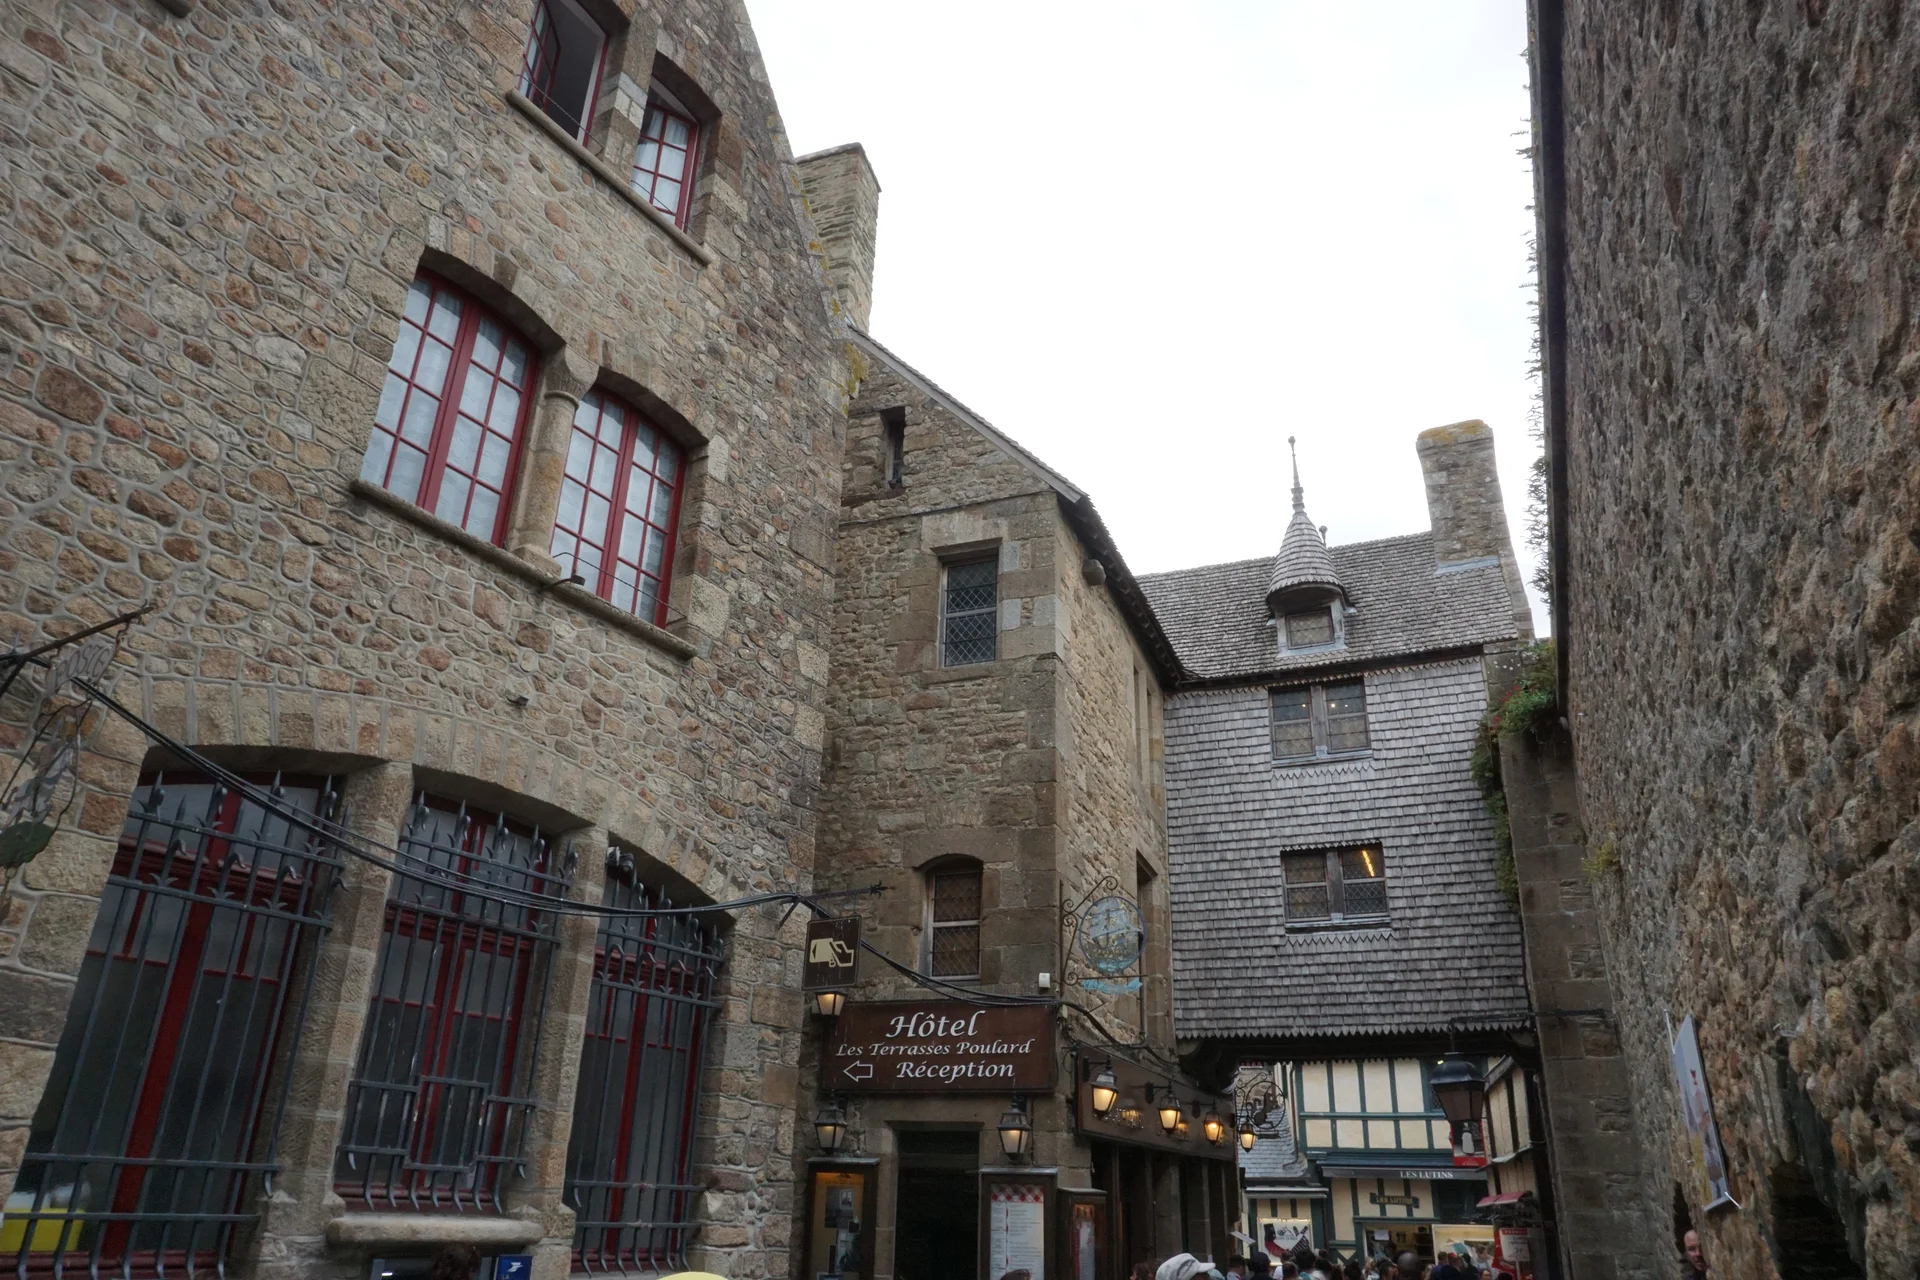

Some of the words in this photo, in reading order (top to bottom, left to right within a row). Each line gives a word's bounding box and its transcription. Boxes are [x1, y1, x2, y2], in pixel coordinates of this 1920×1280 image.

[885, 1010, 986, 1038] Hôtel
[836, 1043, 863, 1057] Les
[869, 1041, 951, 1056] Terrasses
[956, 1039, 1035, 1055] Poulard
[896, 1060, 1016, 1083] Réception
[1400, 1170, 1417, 1179] LES
[1419, 1170, 1454, 1179] LUTINS
